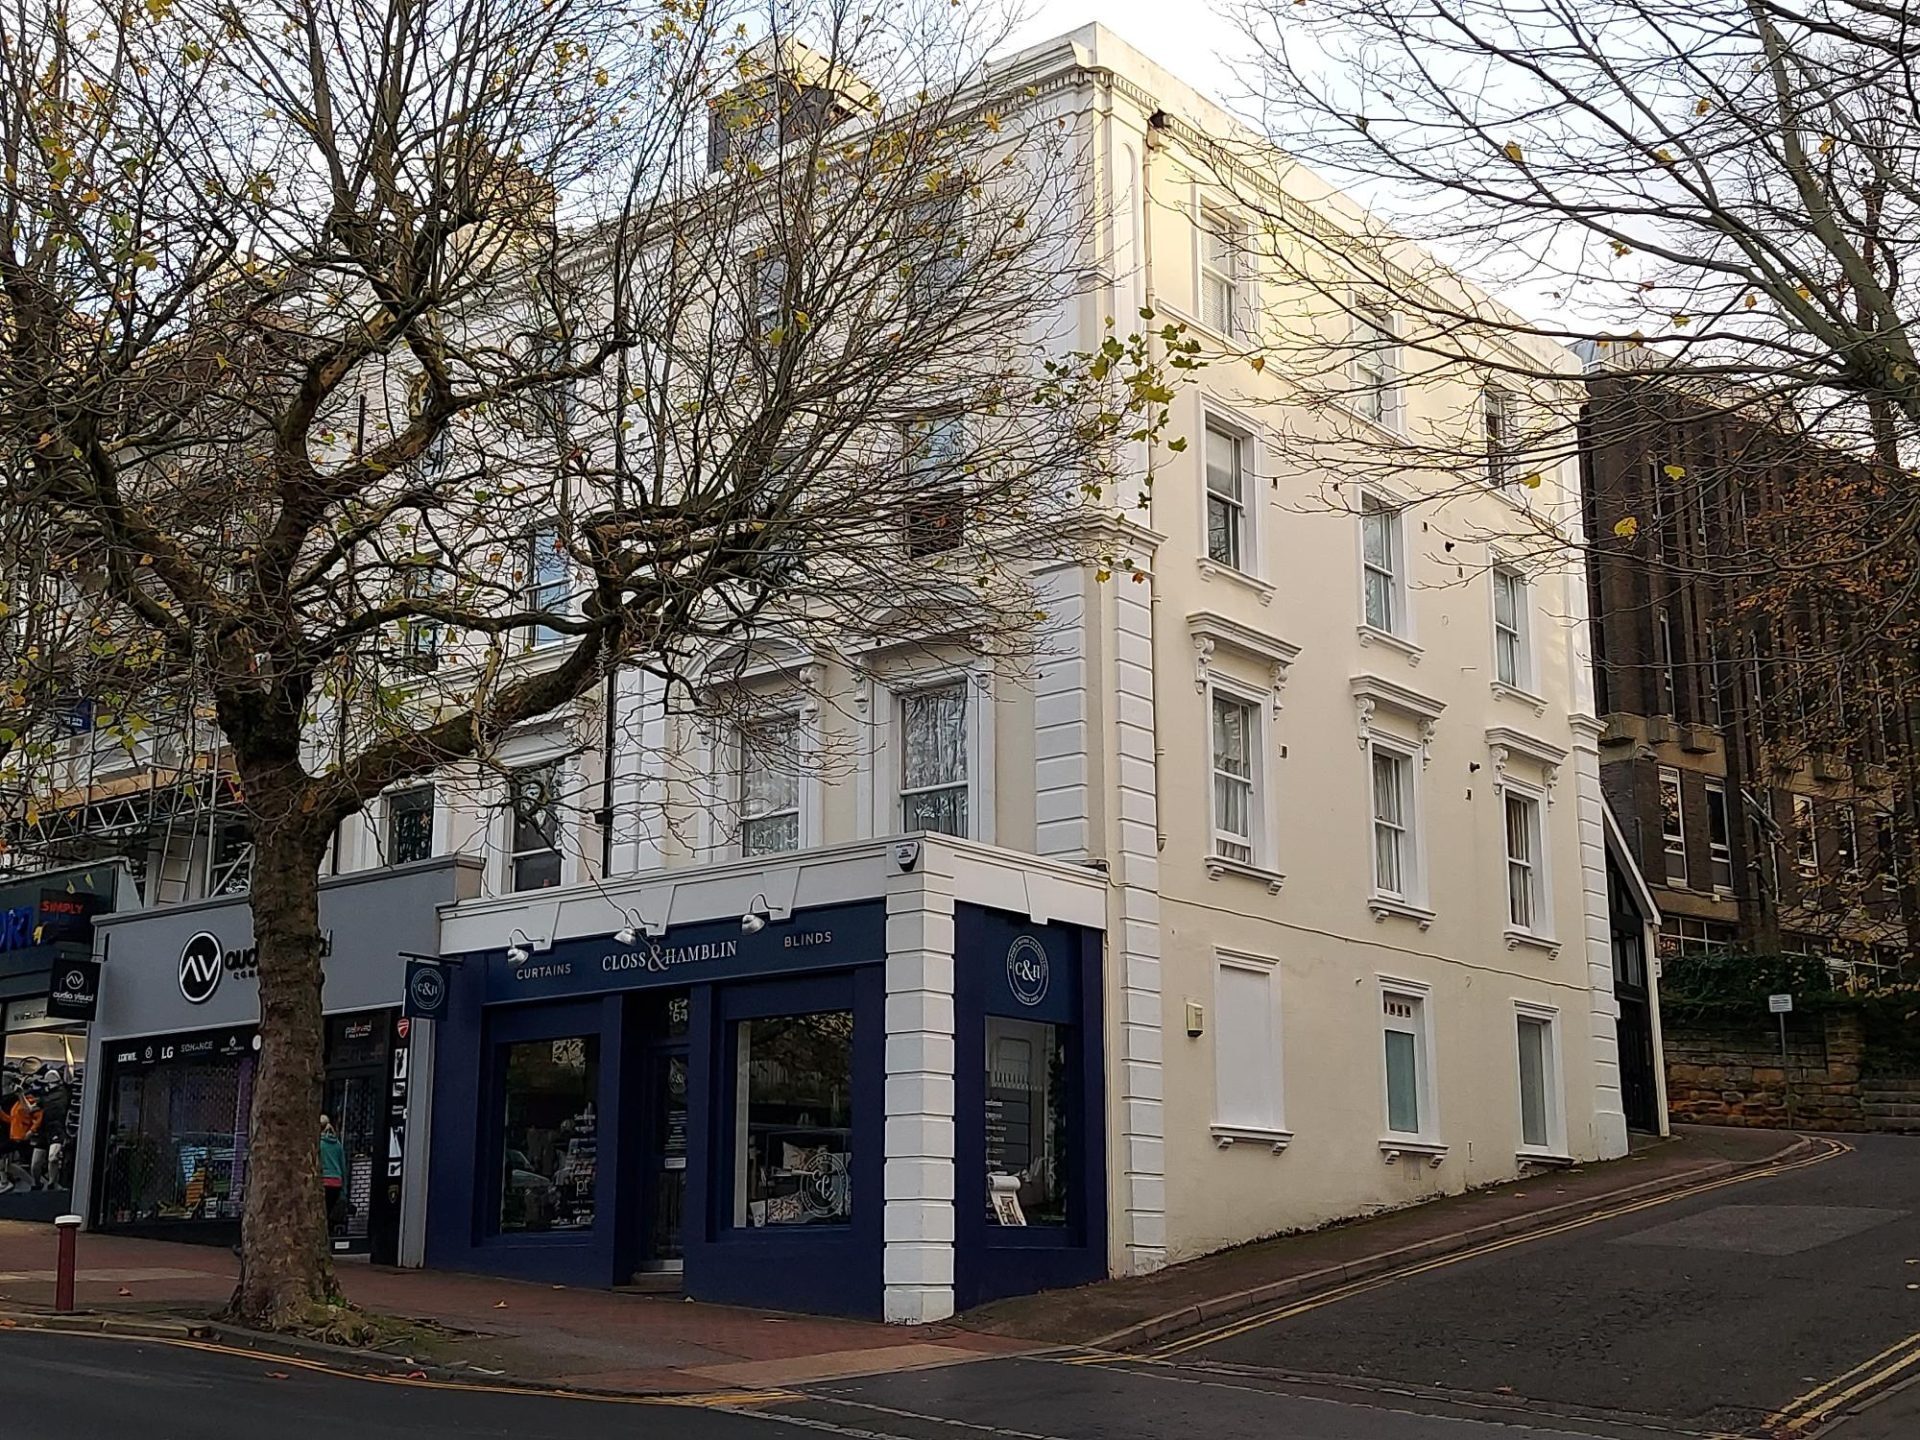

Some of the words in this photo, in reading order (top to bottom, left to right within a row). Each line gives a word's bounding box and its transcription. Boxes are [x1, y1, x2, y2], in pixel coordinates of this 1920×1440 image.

[40, 900, 84, 915] SIMPLY
[784, 931, 832, 948] BLINDS
[516, 963, 571, 980] CURTAINS
[1015, 959, 1040, 982] C&H
[672, 1009, 688, 1022] 64
[161, 1046, 174, 1059] LG
